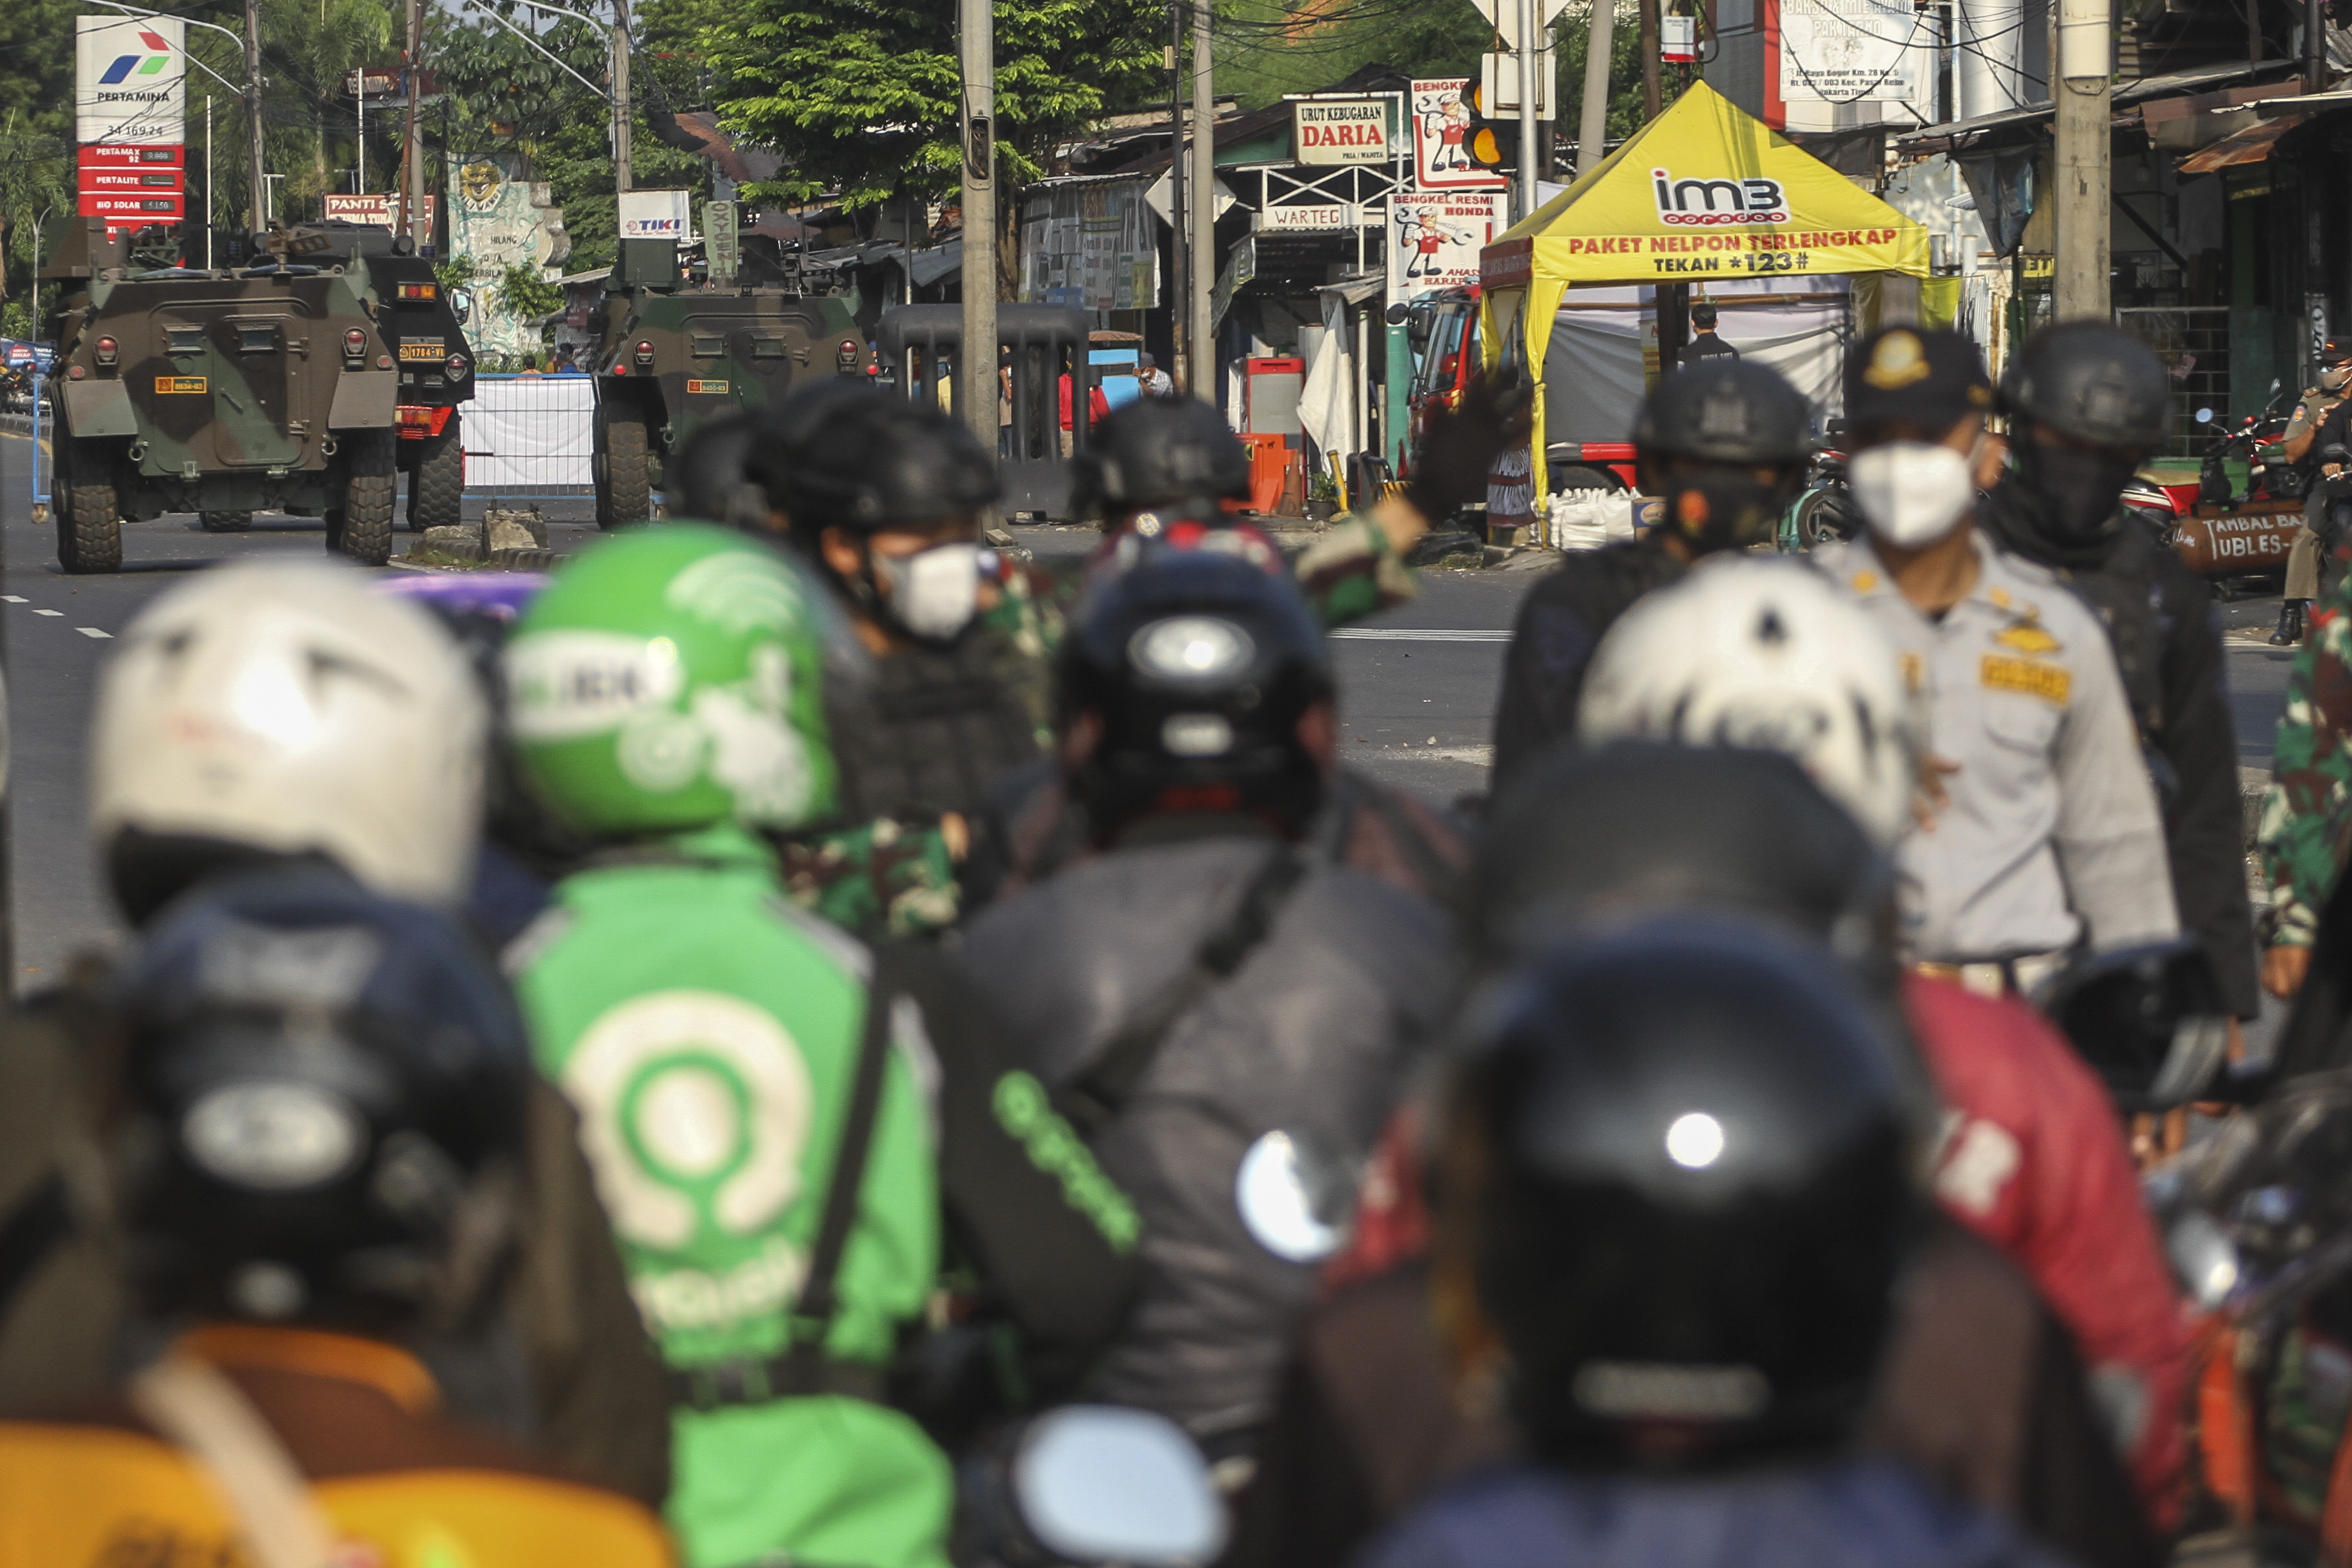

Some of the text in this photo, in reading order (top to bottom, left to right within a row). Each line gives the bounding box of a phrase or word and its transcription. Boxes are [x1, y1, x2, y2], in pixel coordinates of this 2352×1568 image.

[98, 92, 171, 102] PERTAMINA
[1301, 106, 1382, 121] URUT KEBUGARAN
[1302, 123, 1384, 146] DARIA
[330, 199, 375, 210] PANTI
[1394, 195, 1493, 204] BENGKEL RESMI
[1275, 210, 1339, 224] WARTEG
[1445, 207, 1494, 216] HONDA
[639, 219, 680, 230] TIKI
[1569, 229, 1896, 254] PAKET NELPON TERLENGKAP
[1654, 258, 1719, 272] TEKAN
[2276, 514, 2304, 527] BA
